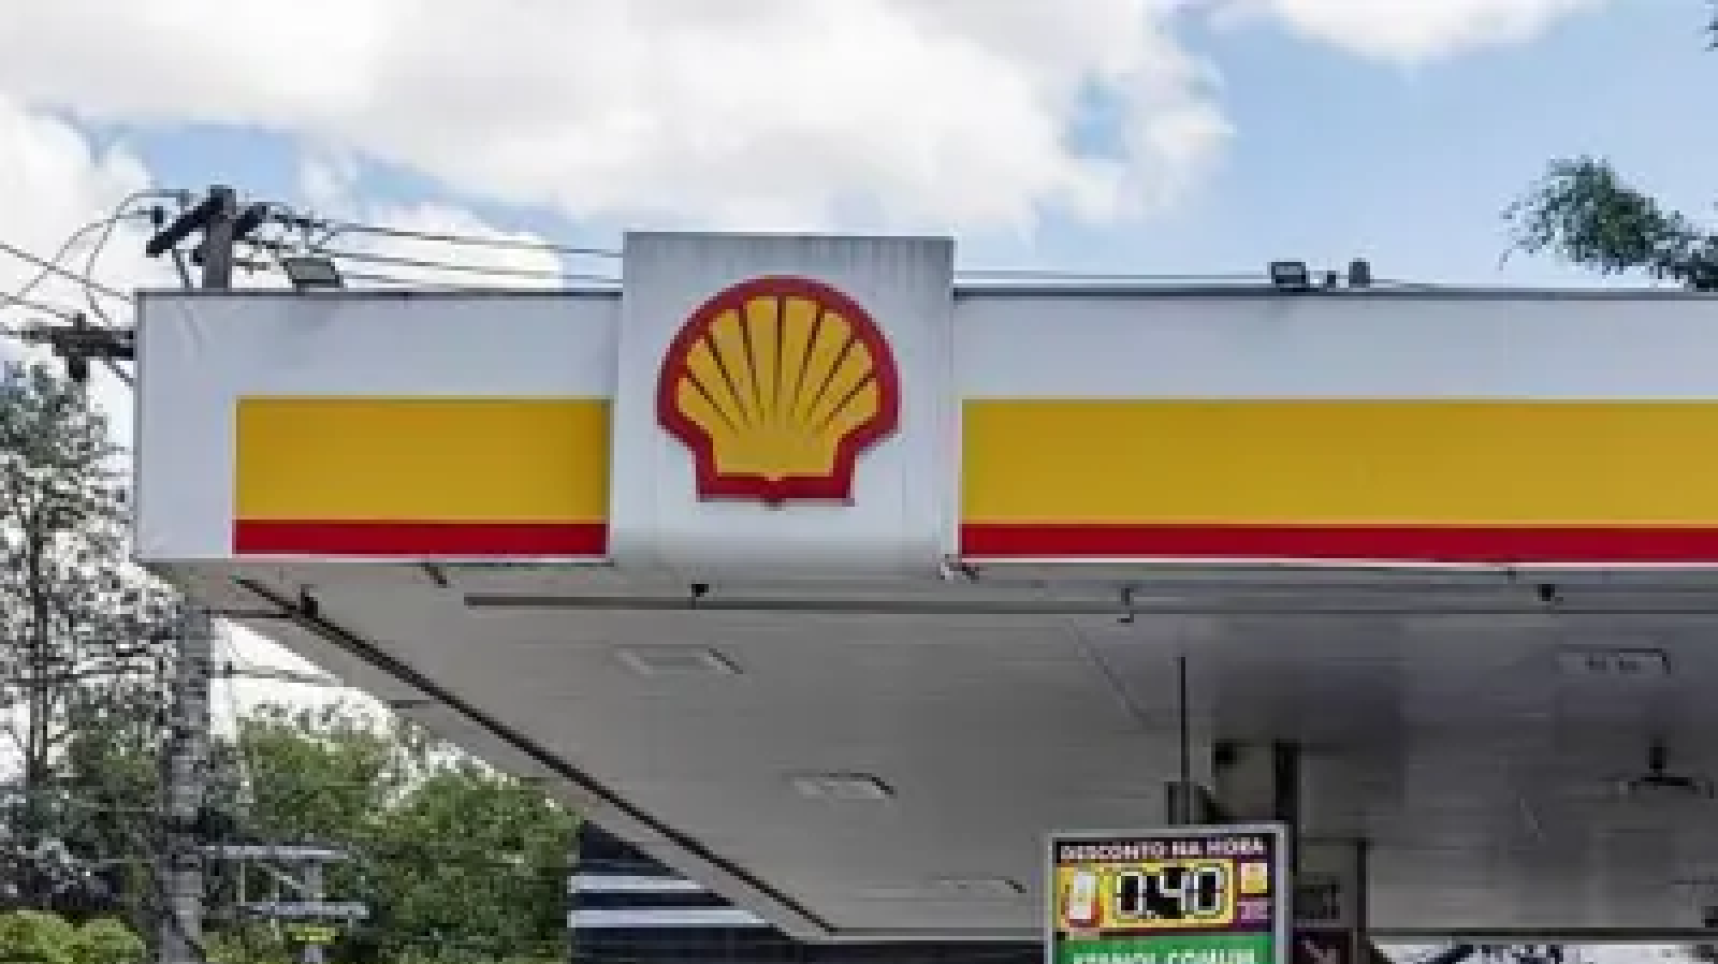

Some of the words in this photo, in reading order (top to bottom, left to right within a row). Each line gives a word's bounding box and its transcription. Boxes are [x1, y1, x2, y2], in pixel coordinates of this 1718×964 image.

[1061, 843, 1165, 861] DESCONTO
[1171, 842, 1202, 858] NA
[1207, 839, 1266, 857] HORA
